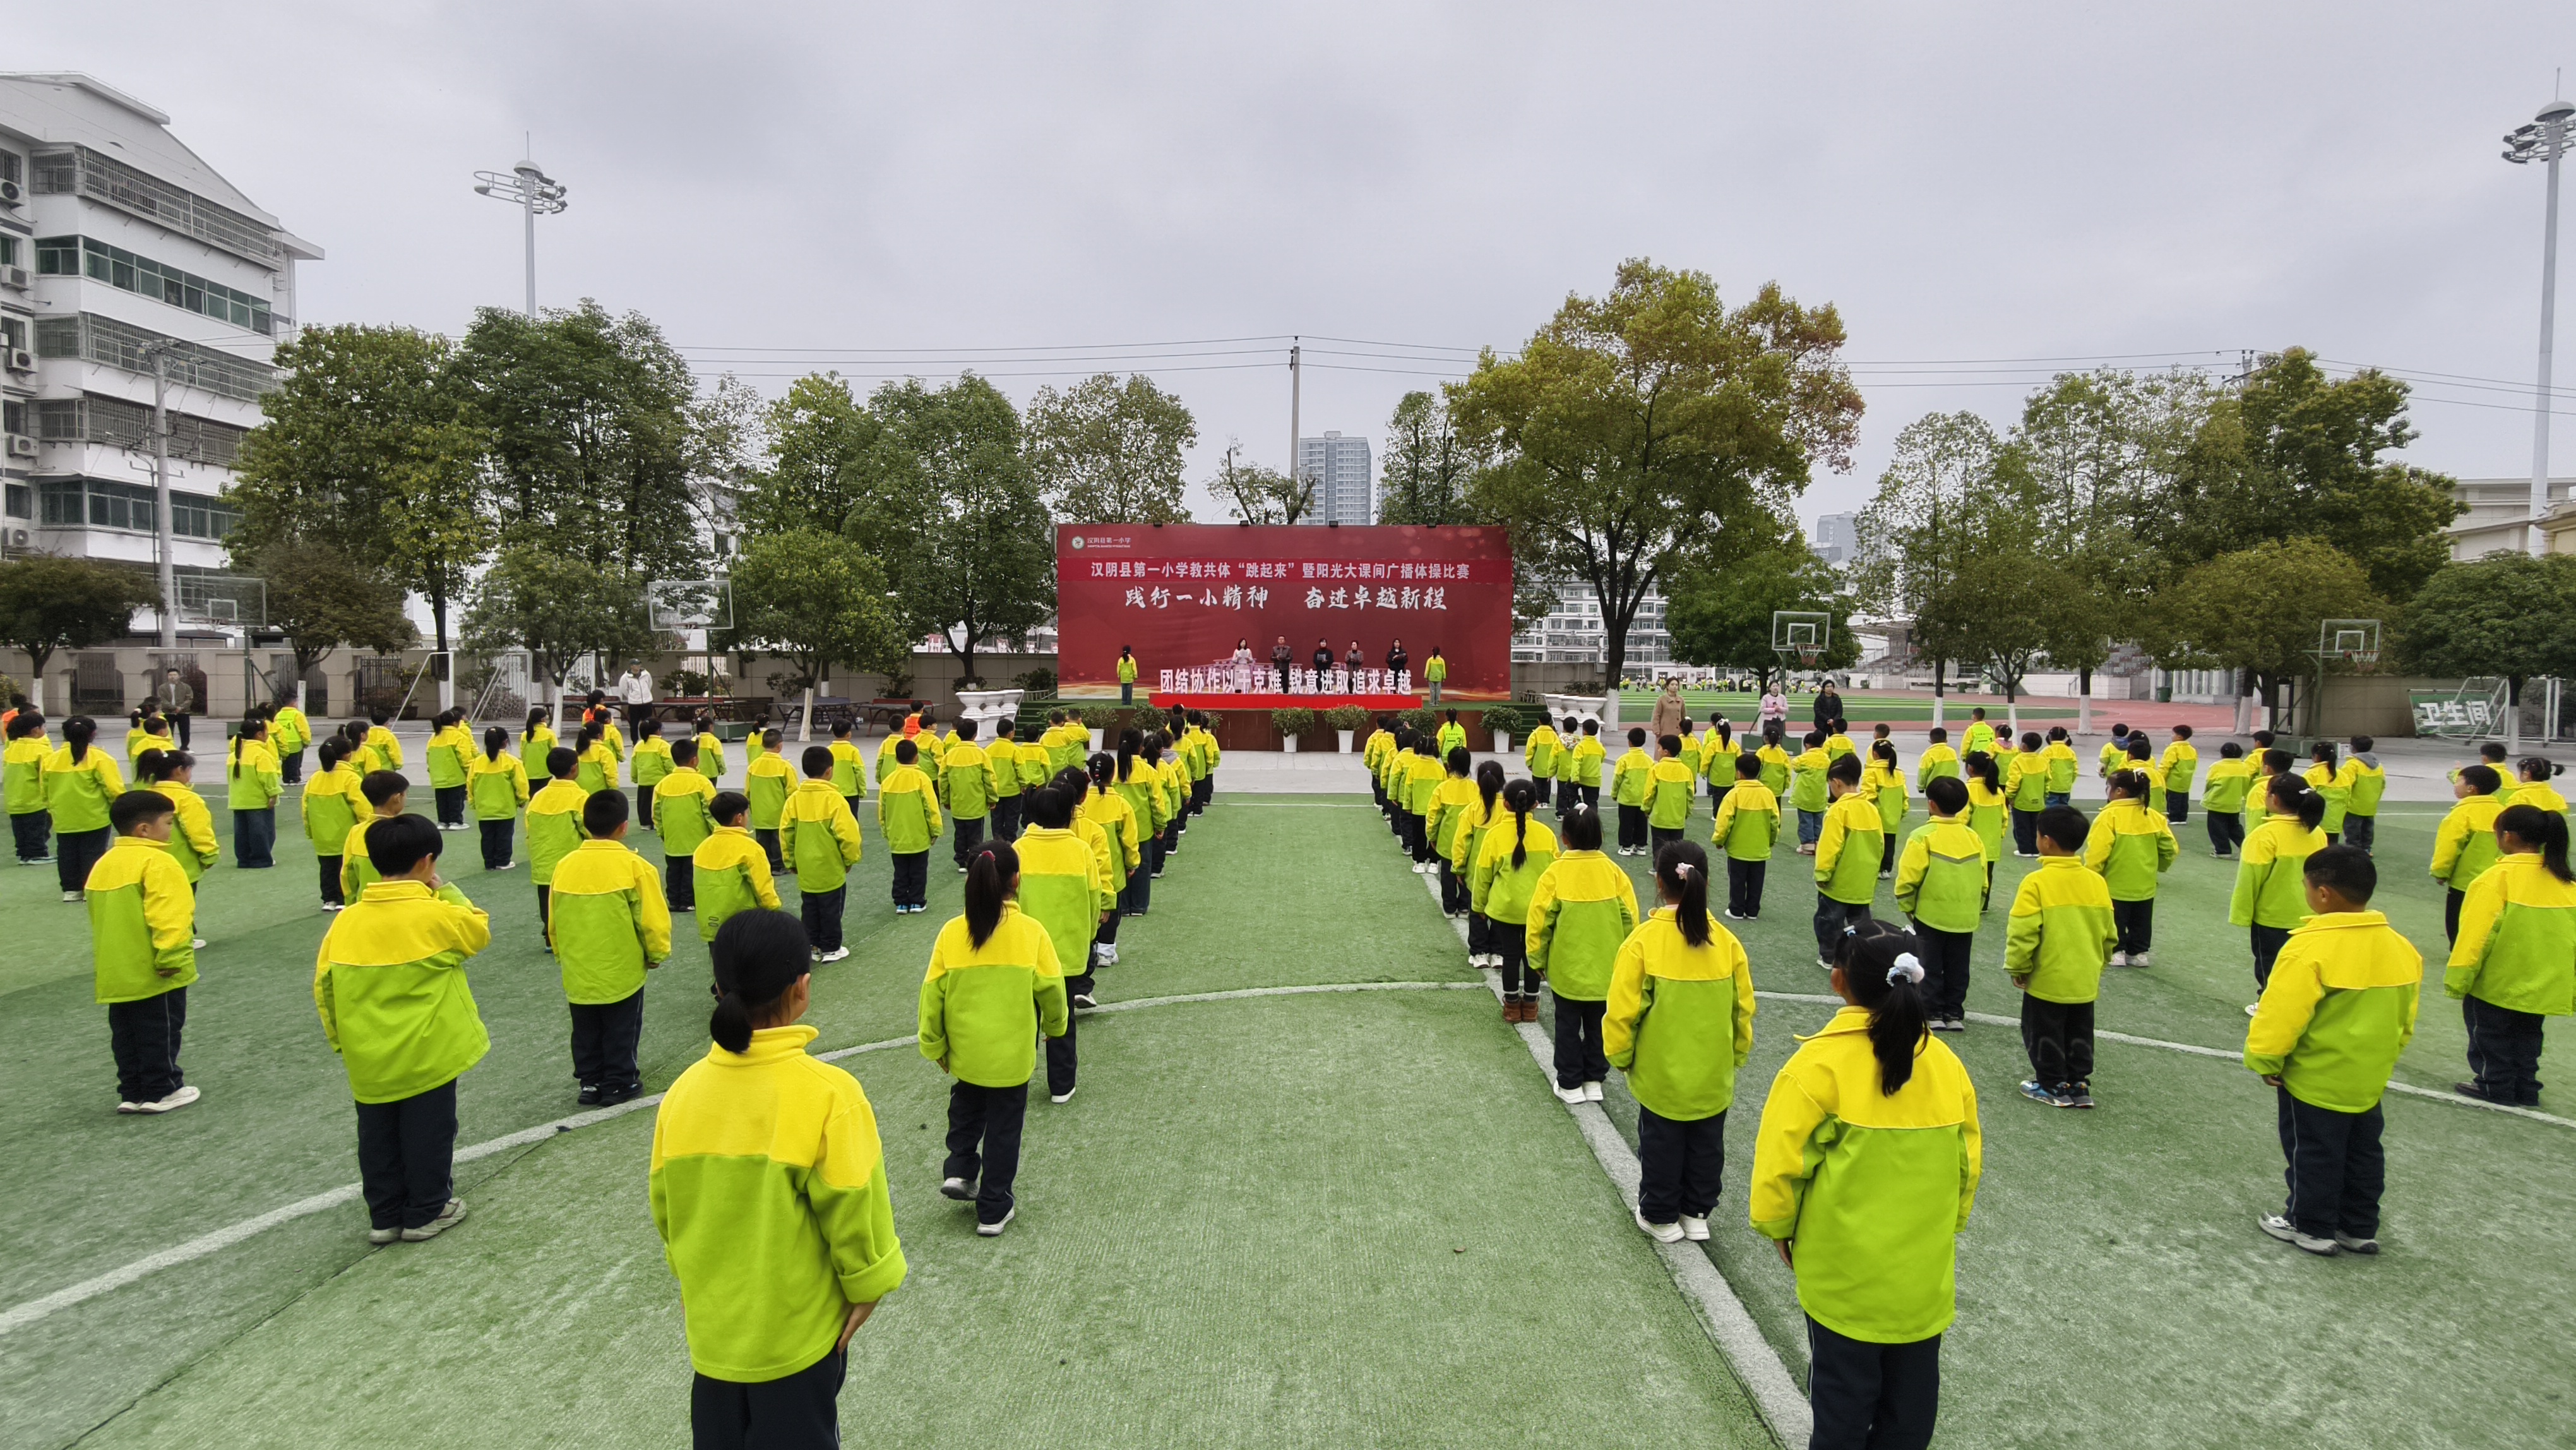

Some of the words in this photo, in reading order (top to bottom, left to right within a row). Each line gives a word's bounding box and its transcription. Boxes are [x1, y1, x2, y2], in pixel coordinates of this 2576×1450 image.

[1124, 585, 1268, 611] 践行一小精神
[1304, 584, 1447, 611] 奋进卓越新程
[1289, 668, 1412, 695] 锐意进取追求卓越
[2419, 700, 2491, 726] 卫生间
